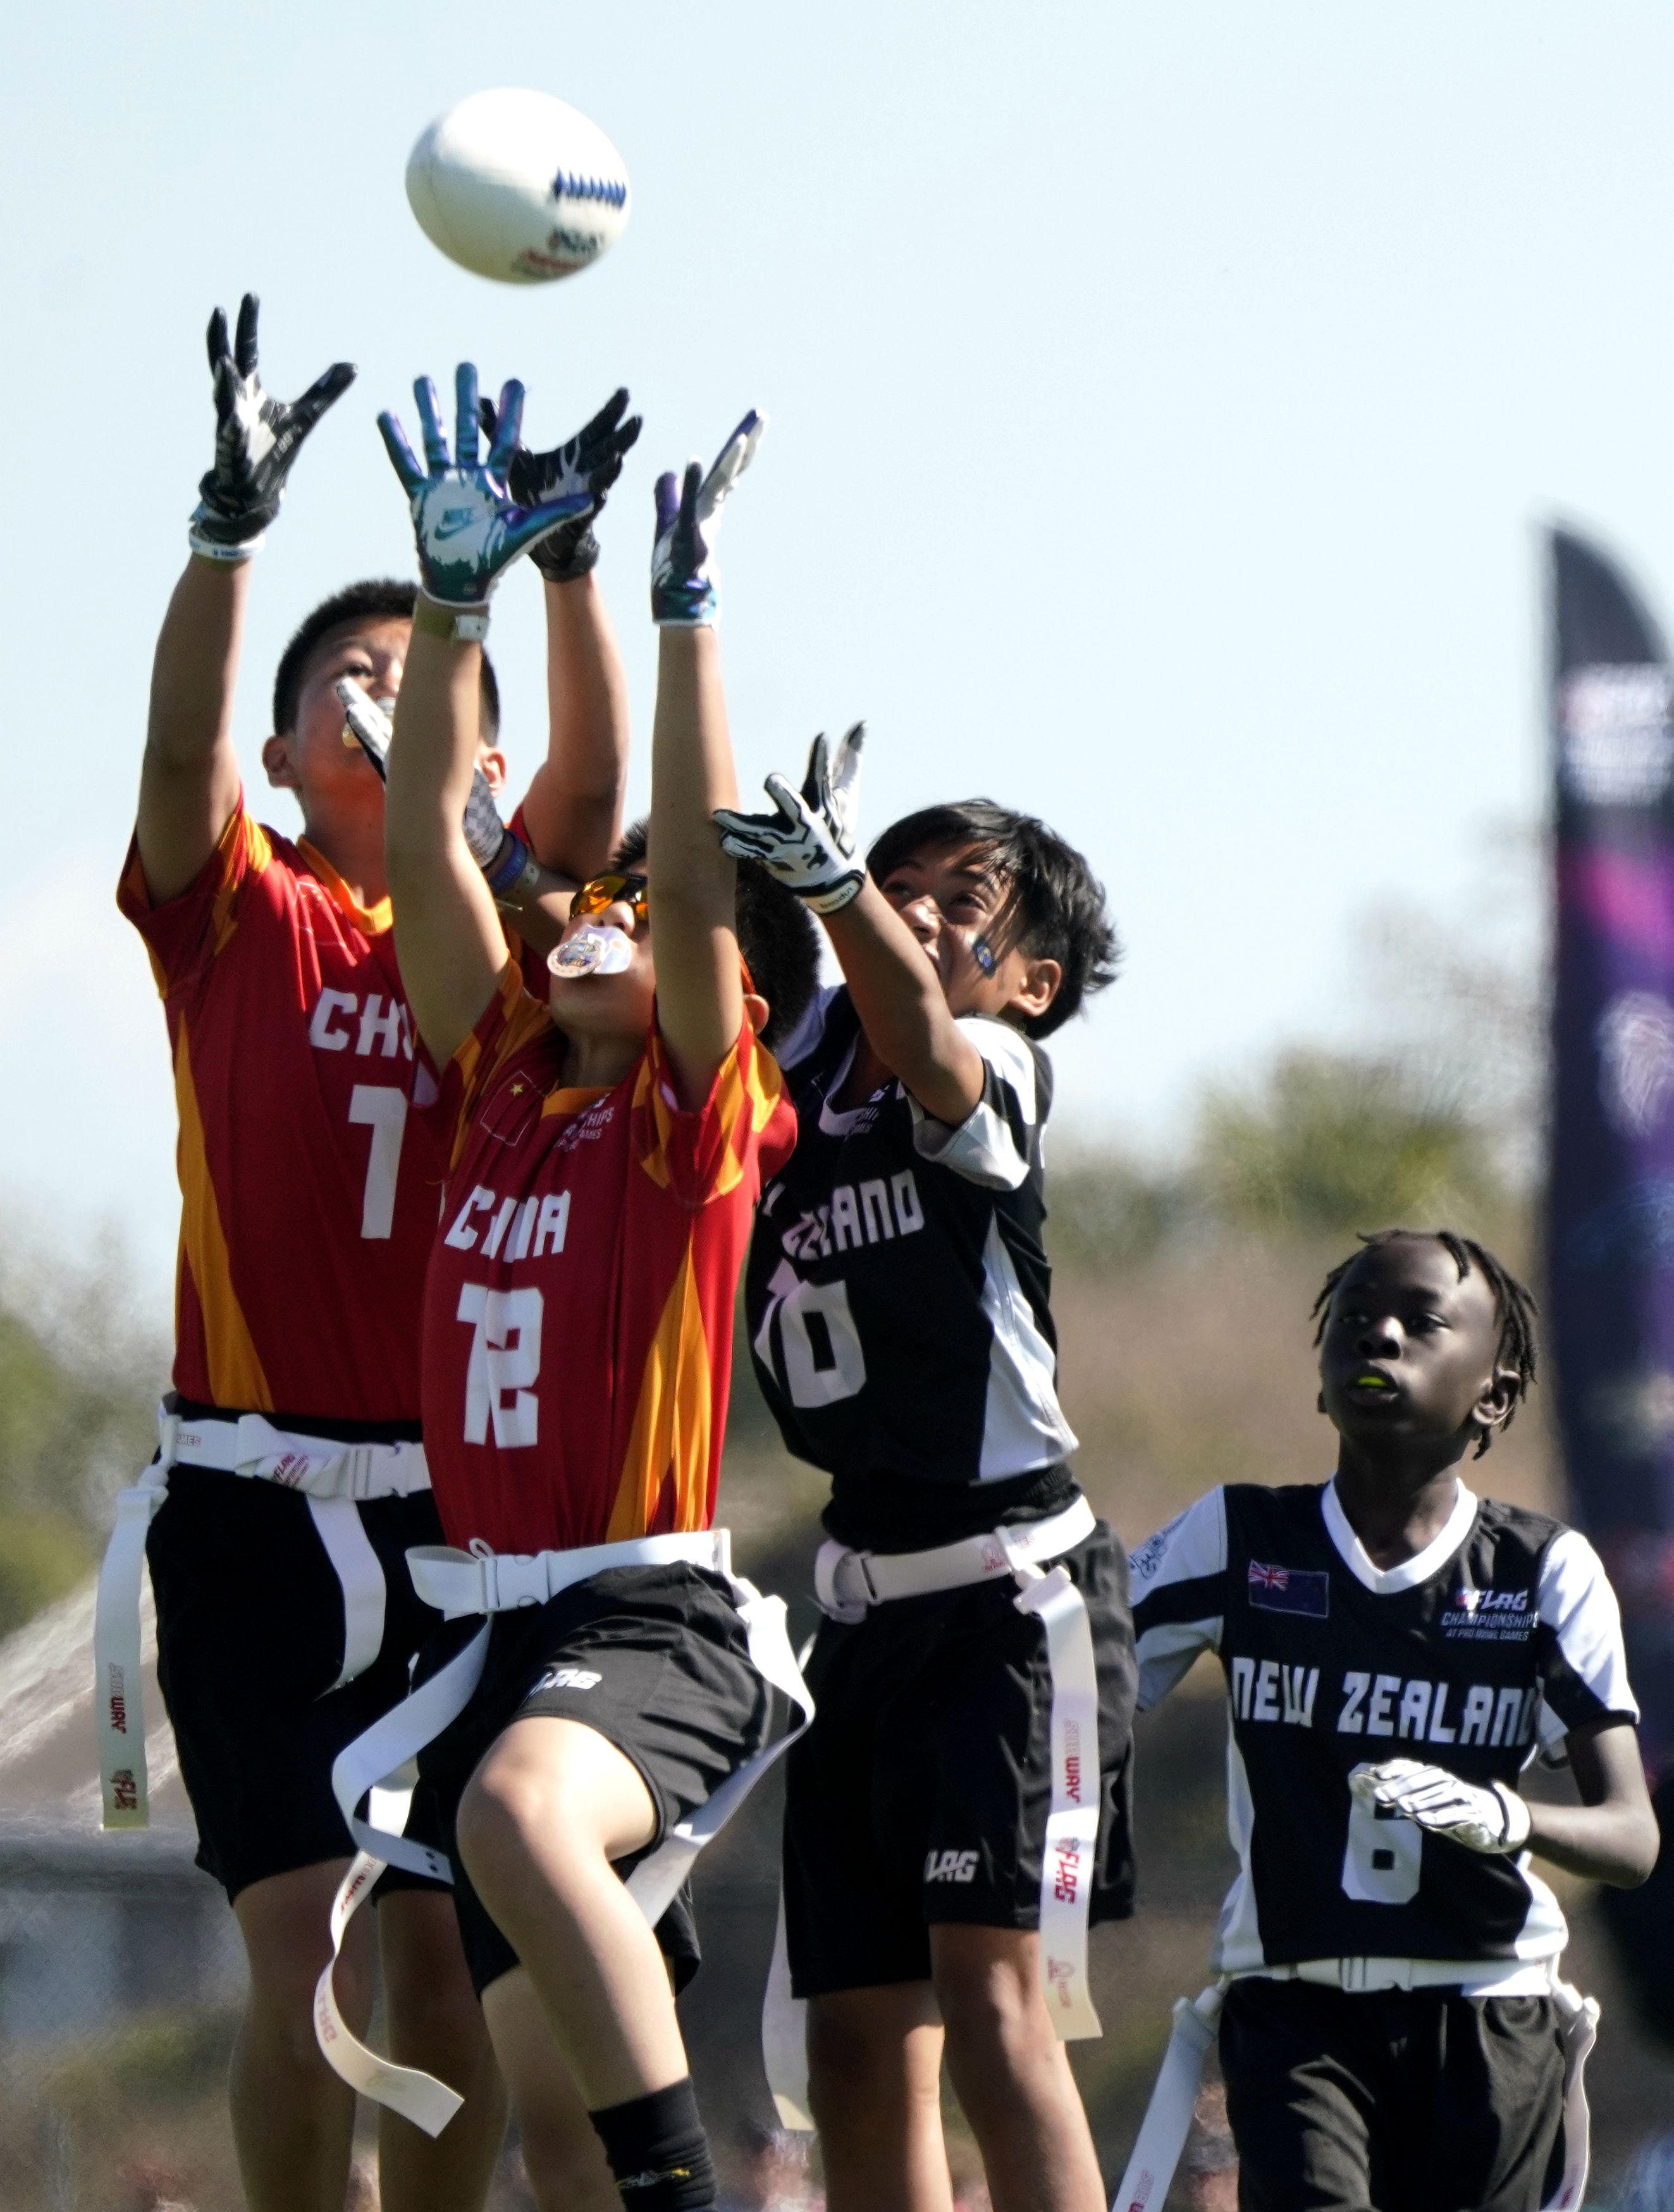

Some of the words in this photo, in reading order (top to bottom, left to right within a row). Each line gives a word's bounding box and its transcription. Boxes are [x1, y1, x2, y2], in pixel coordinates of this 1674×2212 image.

[456, 1282, 545, 1449] 12
[1231, 1656, 1320, 1729] NEW
[1054, 1845, 1080, 1905] FLAG
